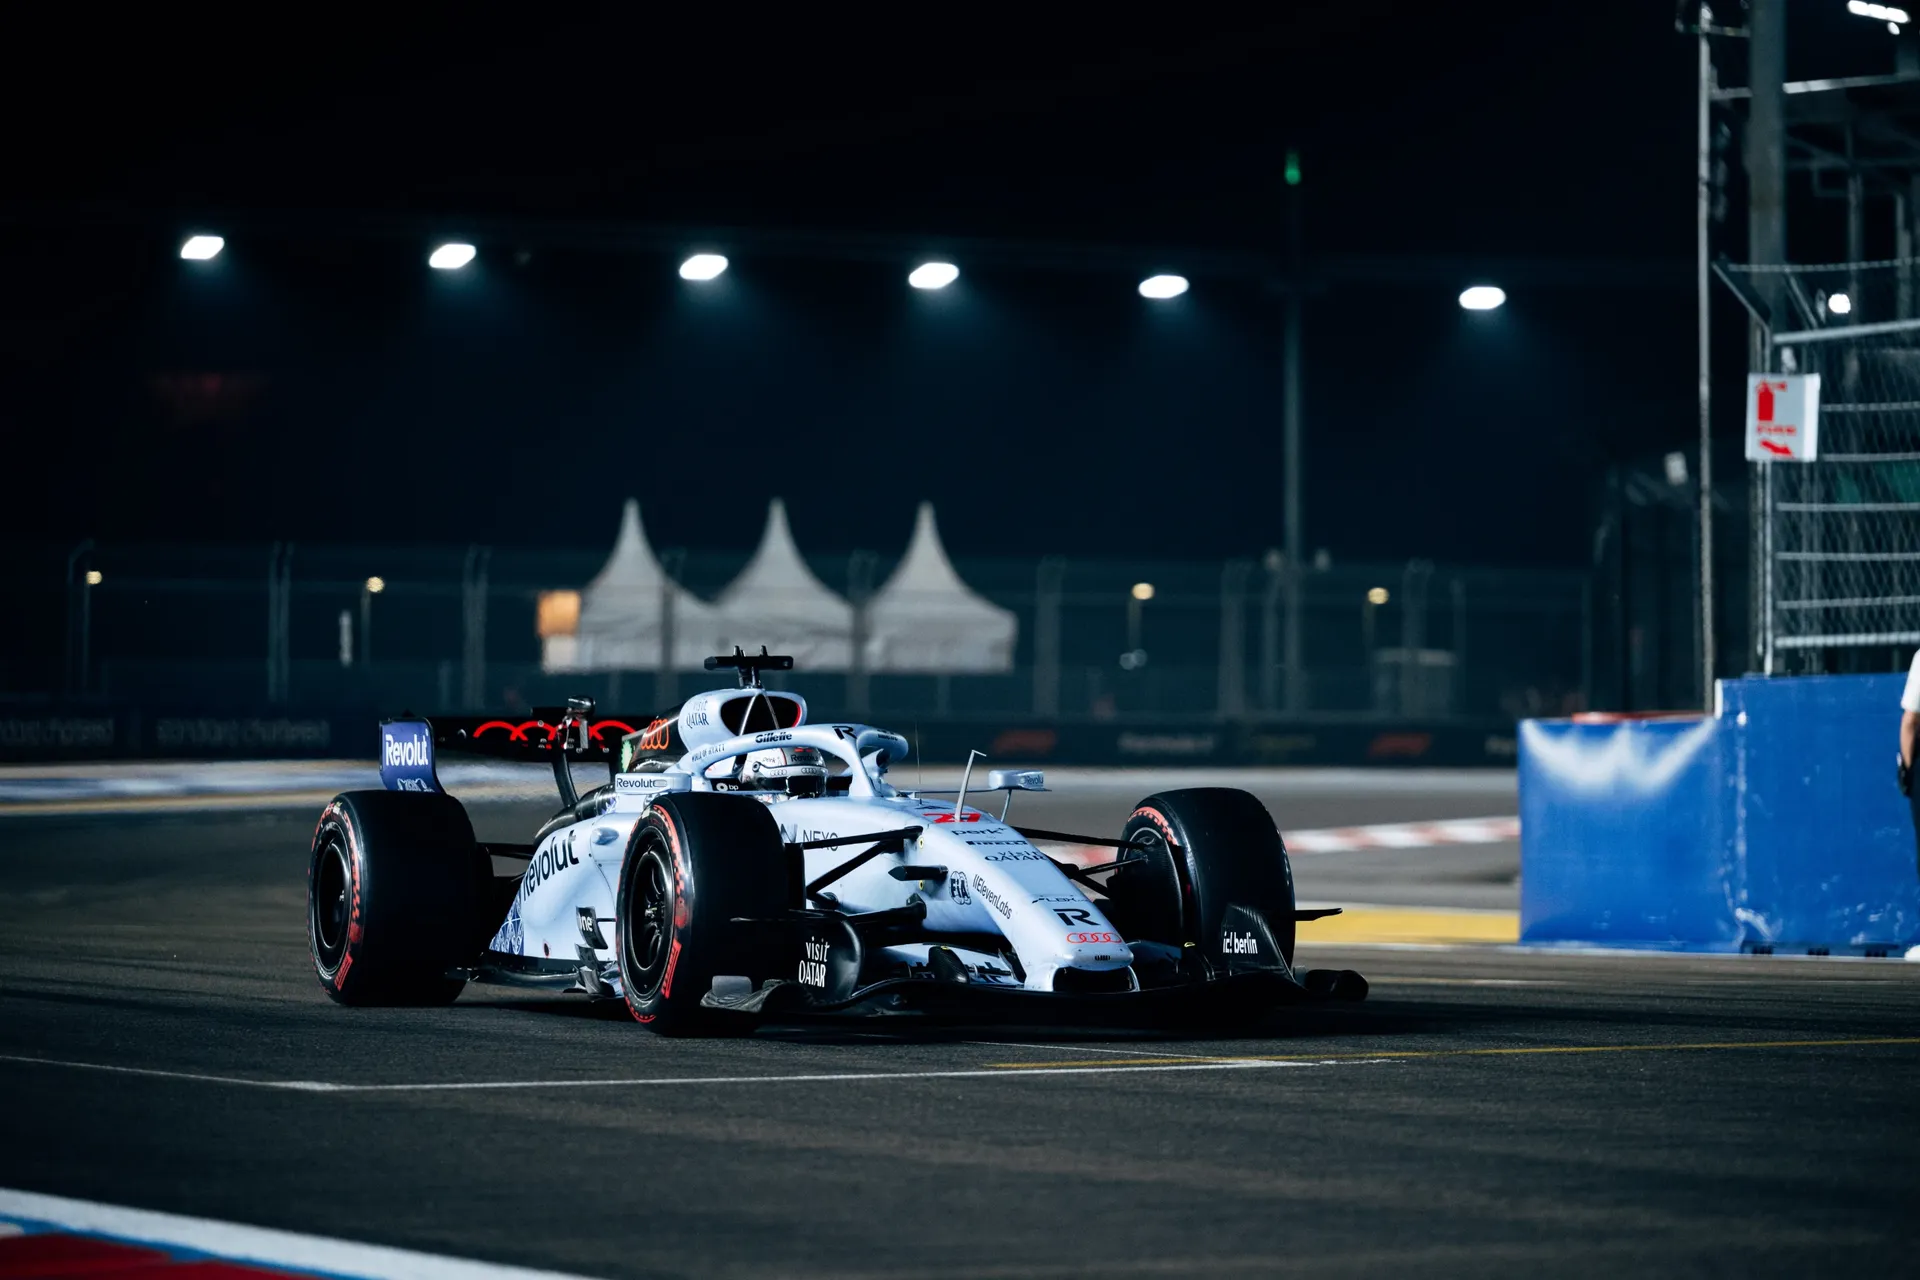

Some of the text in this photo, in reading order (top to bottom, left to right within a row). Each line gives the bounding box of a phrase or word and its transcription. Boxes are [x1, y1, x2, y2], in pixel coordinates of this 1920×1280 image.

[686, 712, 709, 729] QATAR
[755, 731, 793, 744] Gillette
[385, 733, 429, 766] Revolut
[617, 778, 653, 788] Revolut
[729, 783, 739, 791] bp
[1053, 908, 1100, 926] R
[805, 935, 831, 963] visit
[1233, 931, 1258, 955] berlin
[798, 959, 827, 988] QATAR
